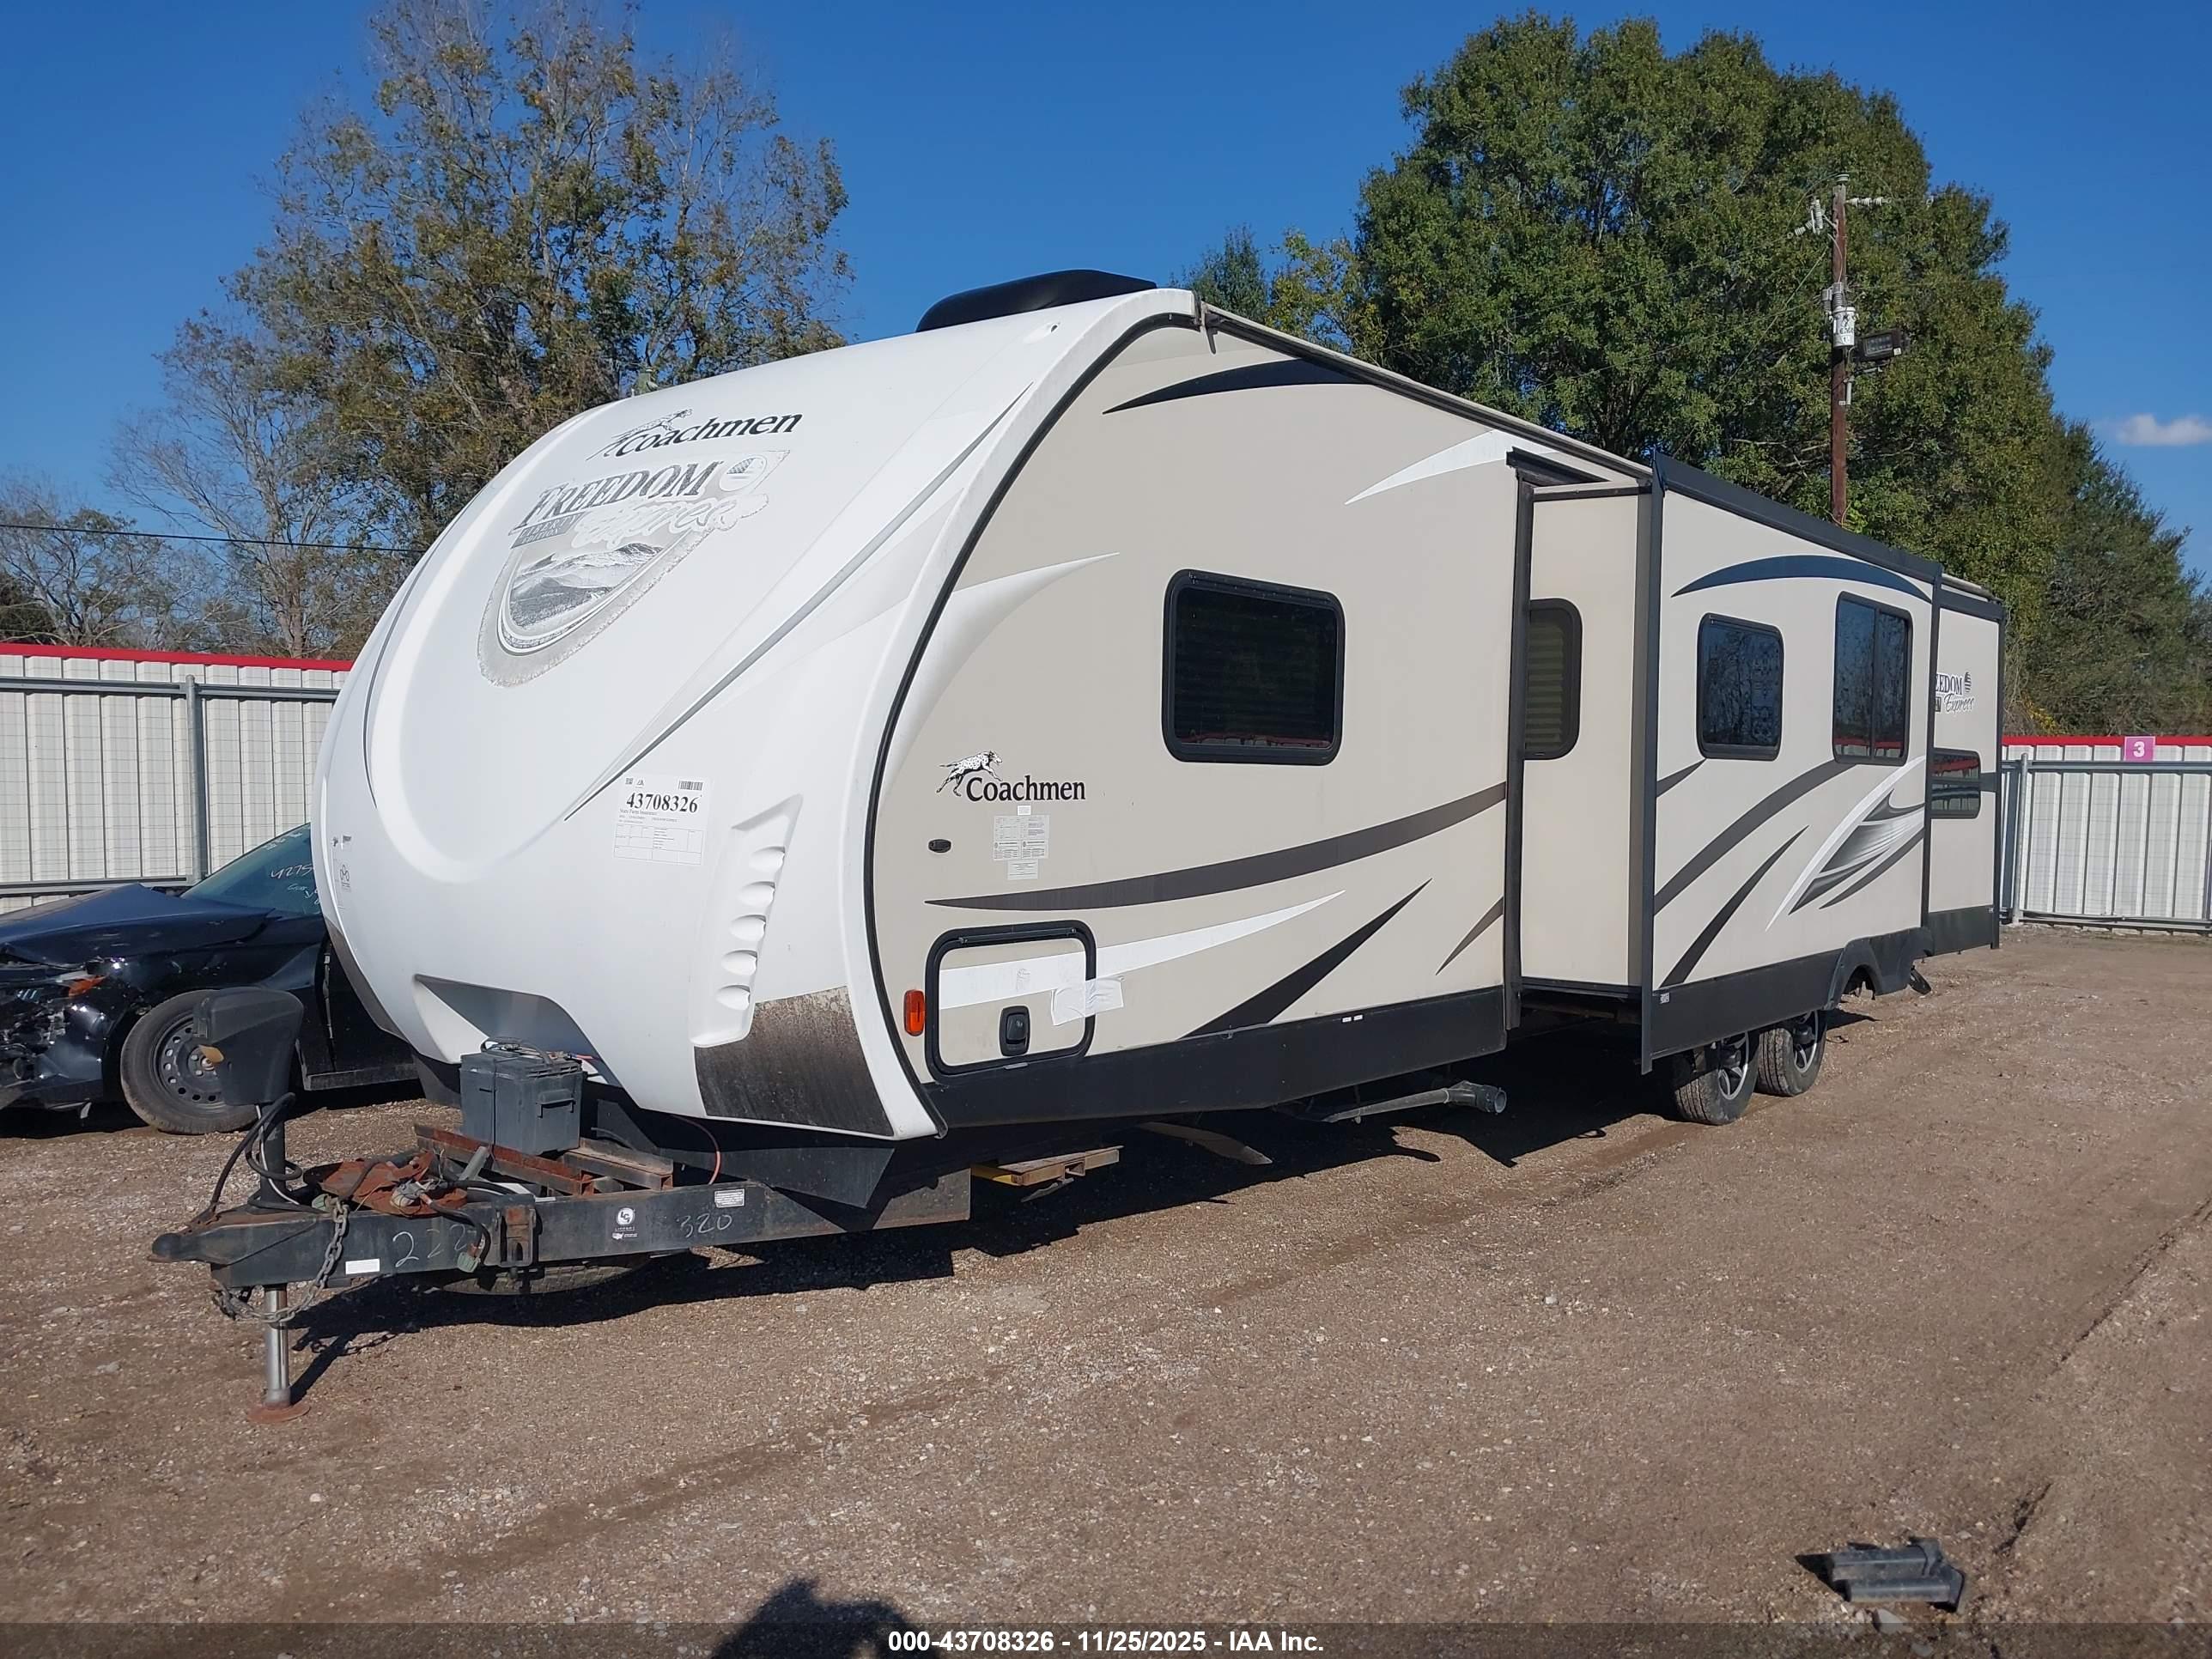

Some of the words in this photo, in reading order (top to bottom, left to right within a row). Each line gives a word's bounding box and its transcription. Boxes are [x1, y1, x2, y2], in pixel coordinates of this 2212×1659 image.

[615, 413, 804, 458] Coachmen
[510, 461, 723, 531] FREEDOM
[1943, 693, 1975, 713] Express
[2133, 741, 2145, 757] 3
[966, 775, 1086, 802] Coachmen
[626, 792, 699, 813] 43708326
[677, 1213, 732, 1238] 320
